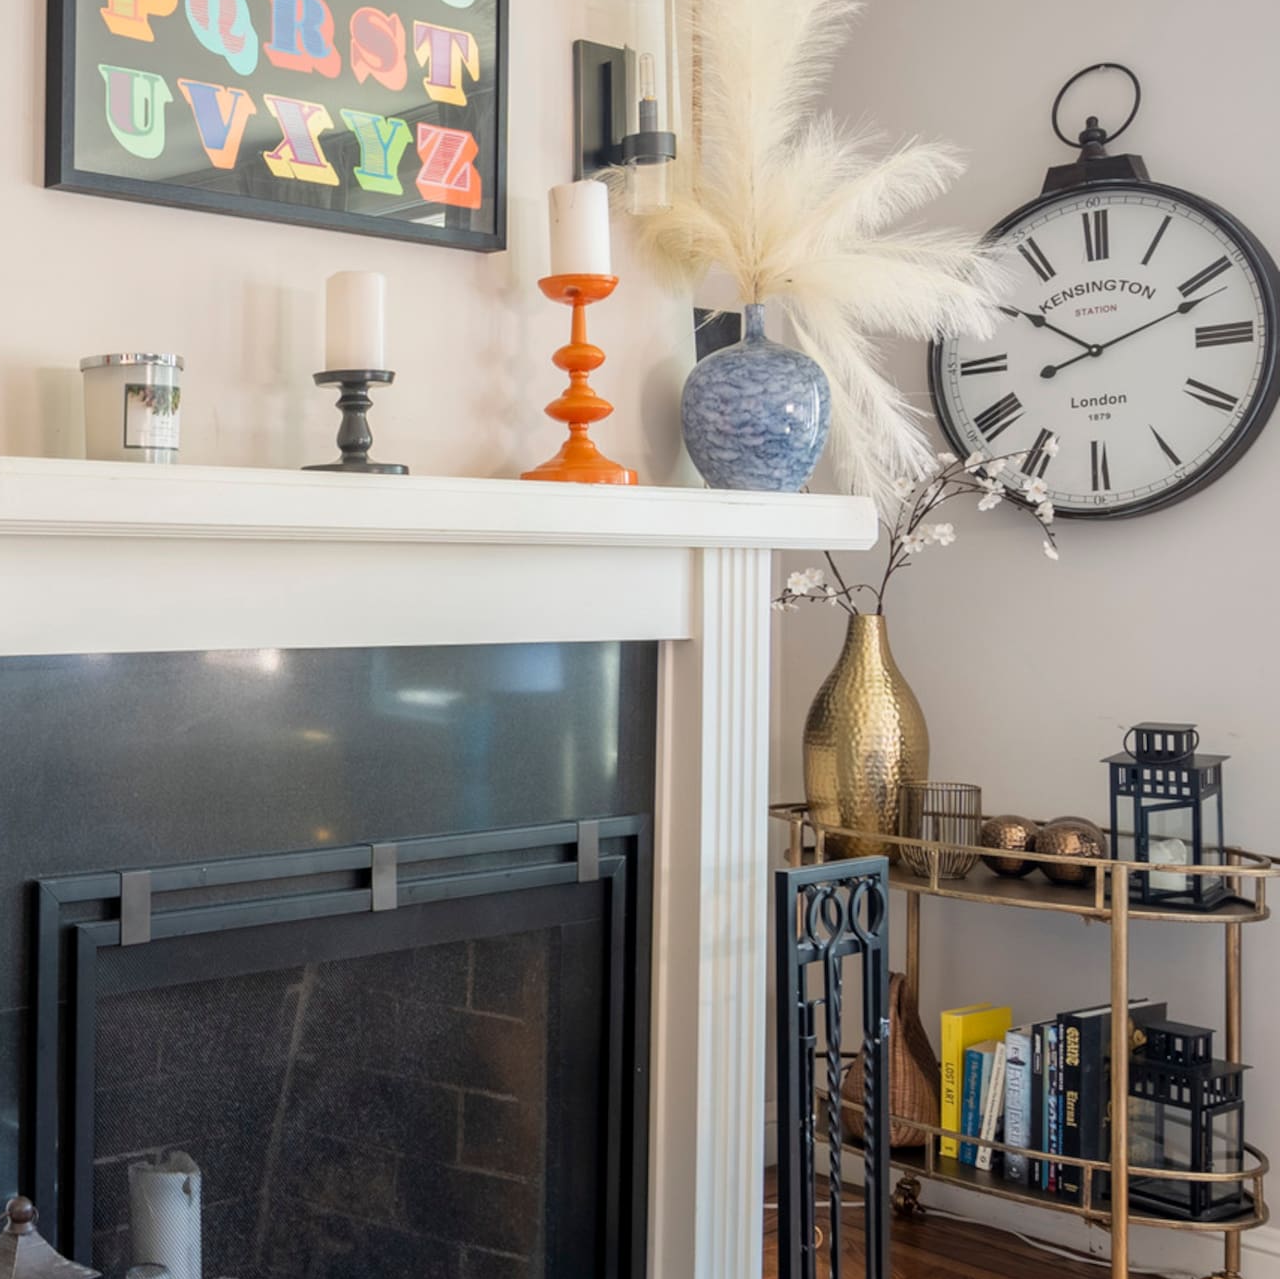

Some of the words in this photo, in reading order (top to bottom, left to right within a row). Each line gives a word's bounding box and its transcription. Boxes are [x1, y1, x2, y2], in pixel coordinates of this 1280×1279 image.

[1086, 196, 1101, 209] 60
[1038, 279, 1157, 314] KENSINGTON
[1075, 304, 1118, 317] STATION
[1070, 393, 1128, 409] London
[1088, 412, 1111, 421] 1879
[945, 1062, 955, 1085] LOST
[945, 1087, 955, 1105] ART
